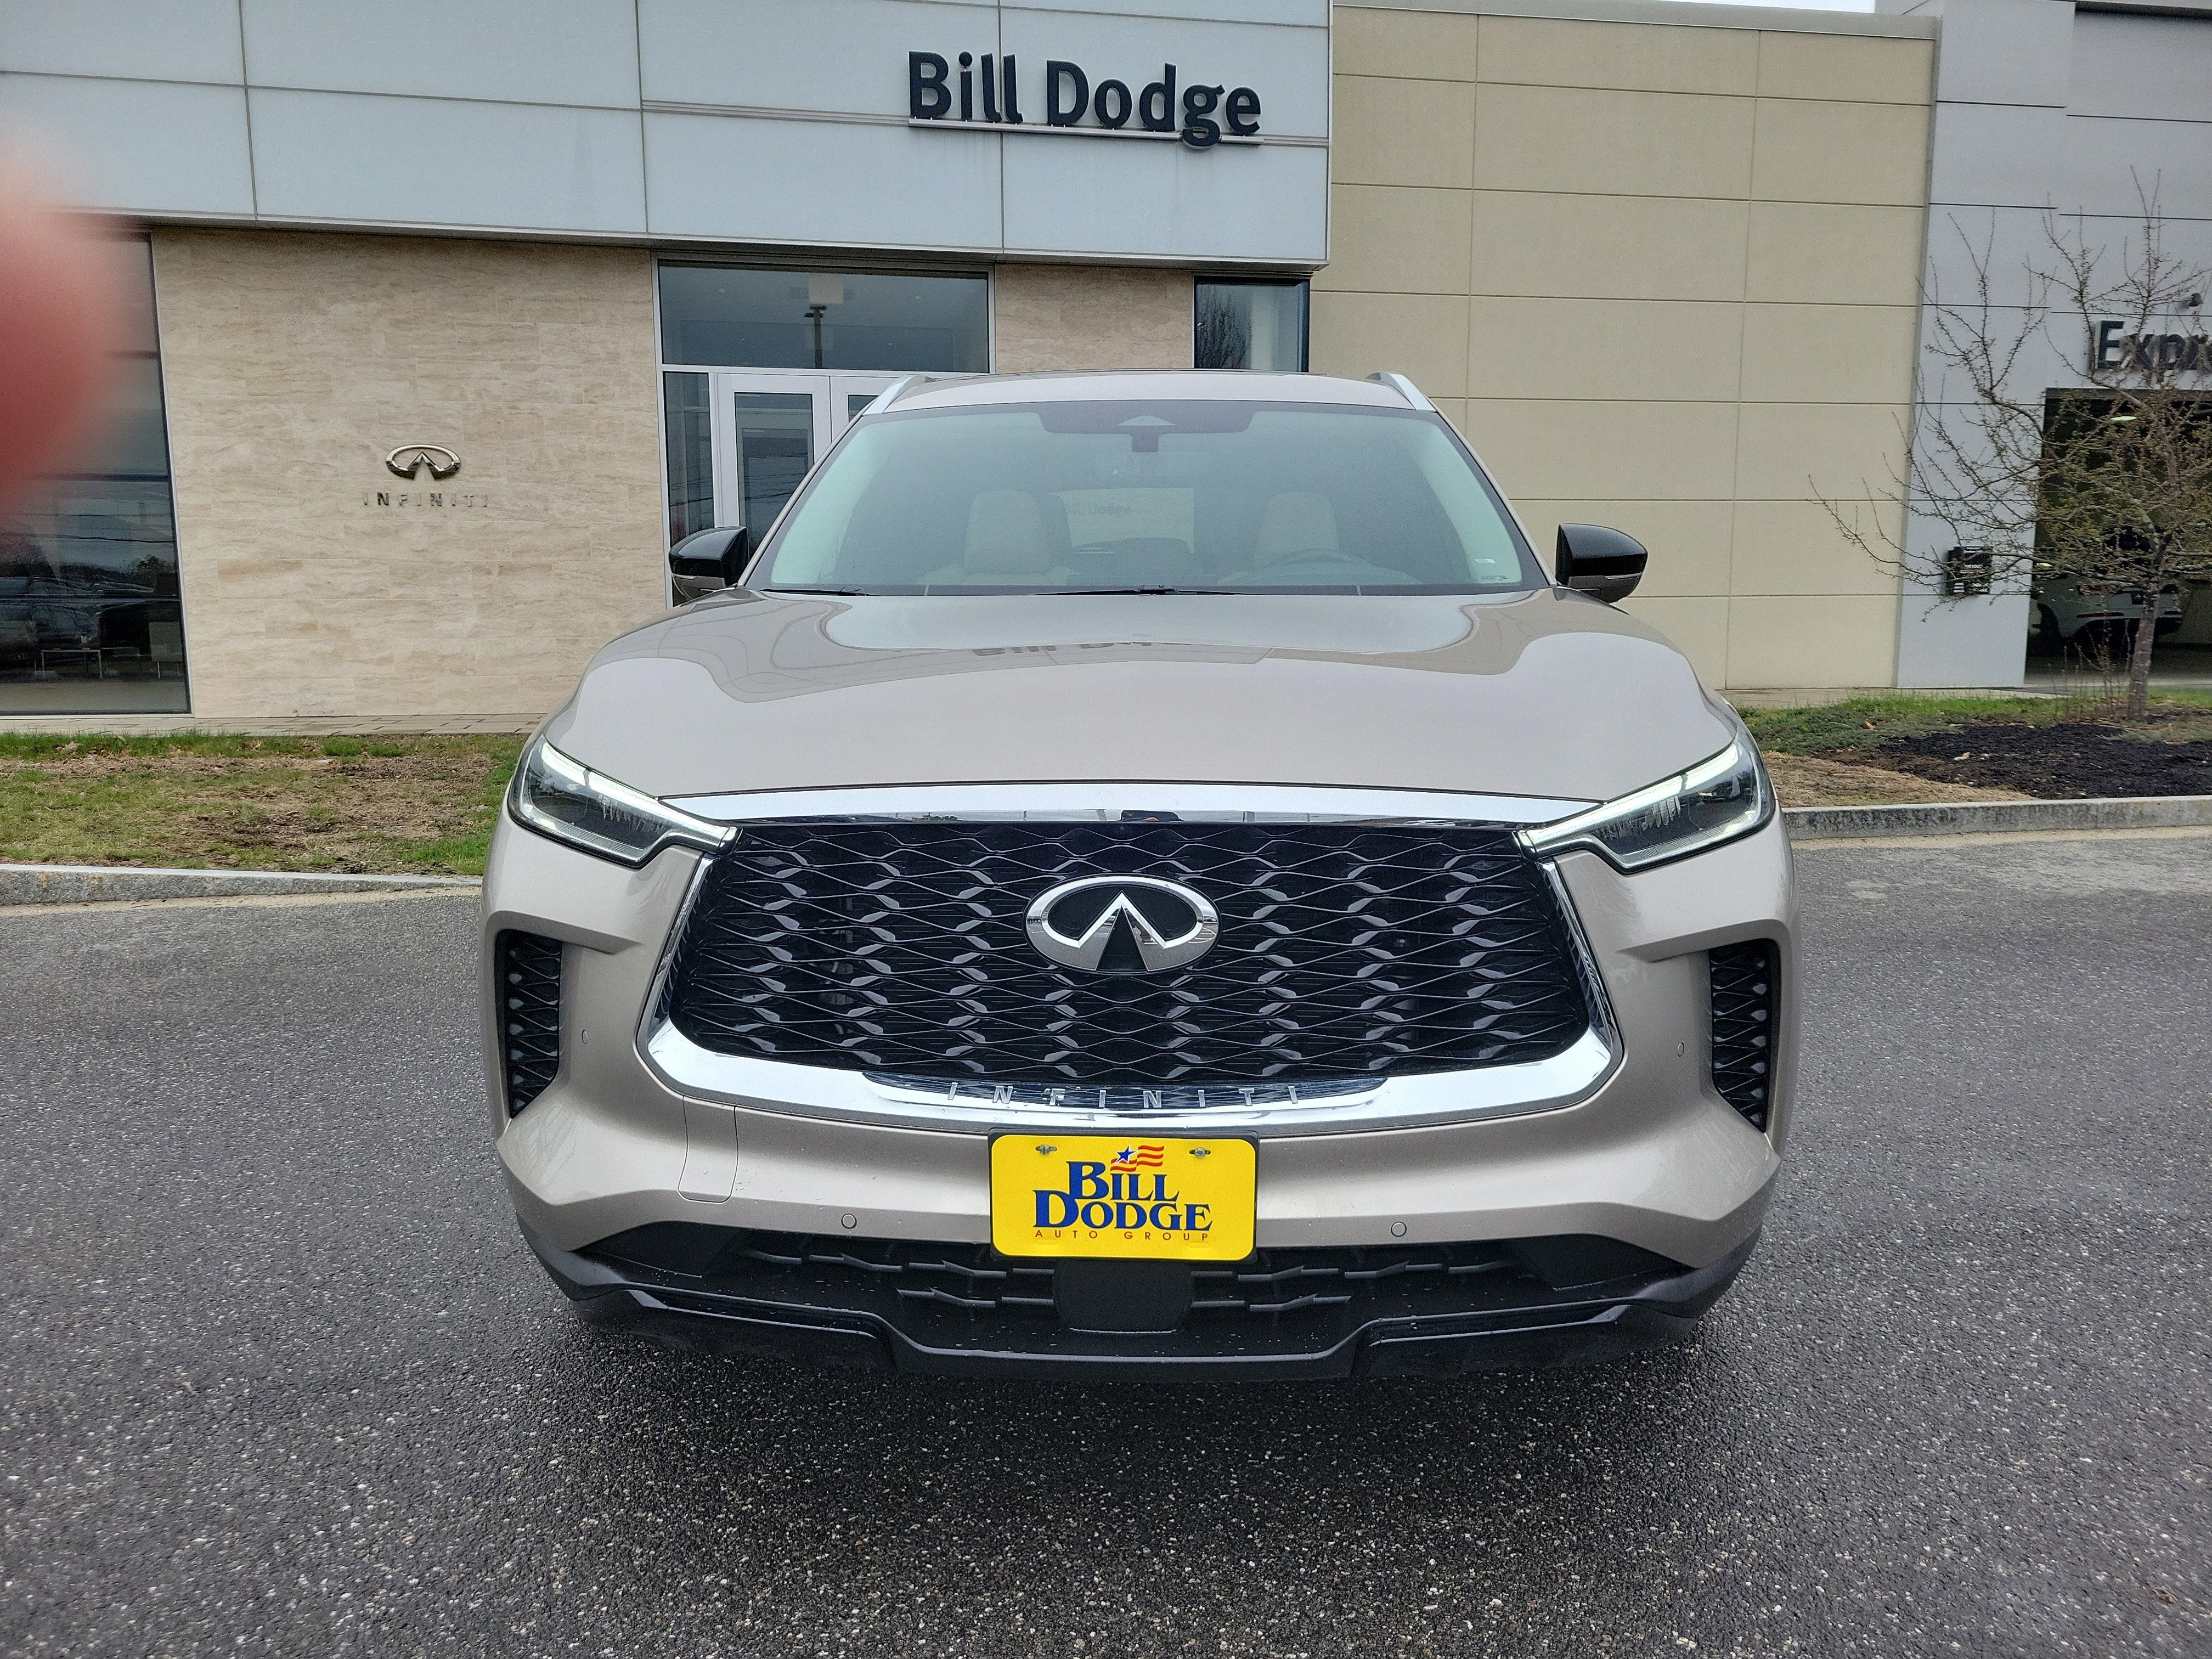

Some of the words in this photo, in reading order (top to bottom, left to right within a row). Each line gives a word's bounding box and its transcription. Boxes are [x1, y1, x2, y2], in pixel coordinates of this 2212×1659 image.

[908, 50, 1024, 123] Bill
[1046, 59, 1261, 148] Dodge
[363, 492, 488, 507] INFINITI
[947, 1082, 1299, 1109] INFINITI
[1065, 1160, 1180, 1201] BILL
[1032, 1189, 1213, 1231] DODGE
[1035, 1230, 1098, 1239] AUTO
[1124, 1231, 1209, 1242] GROUP
